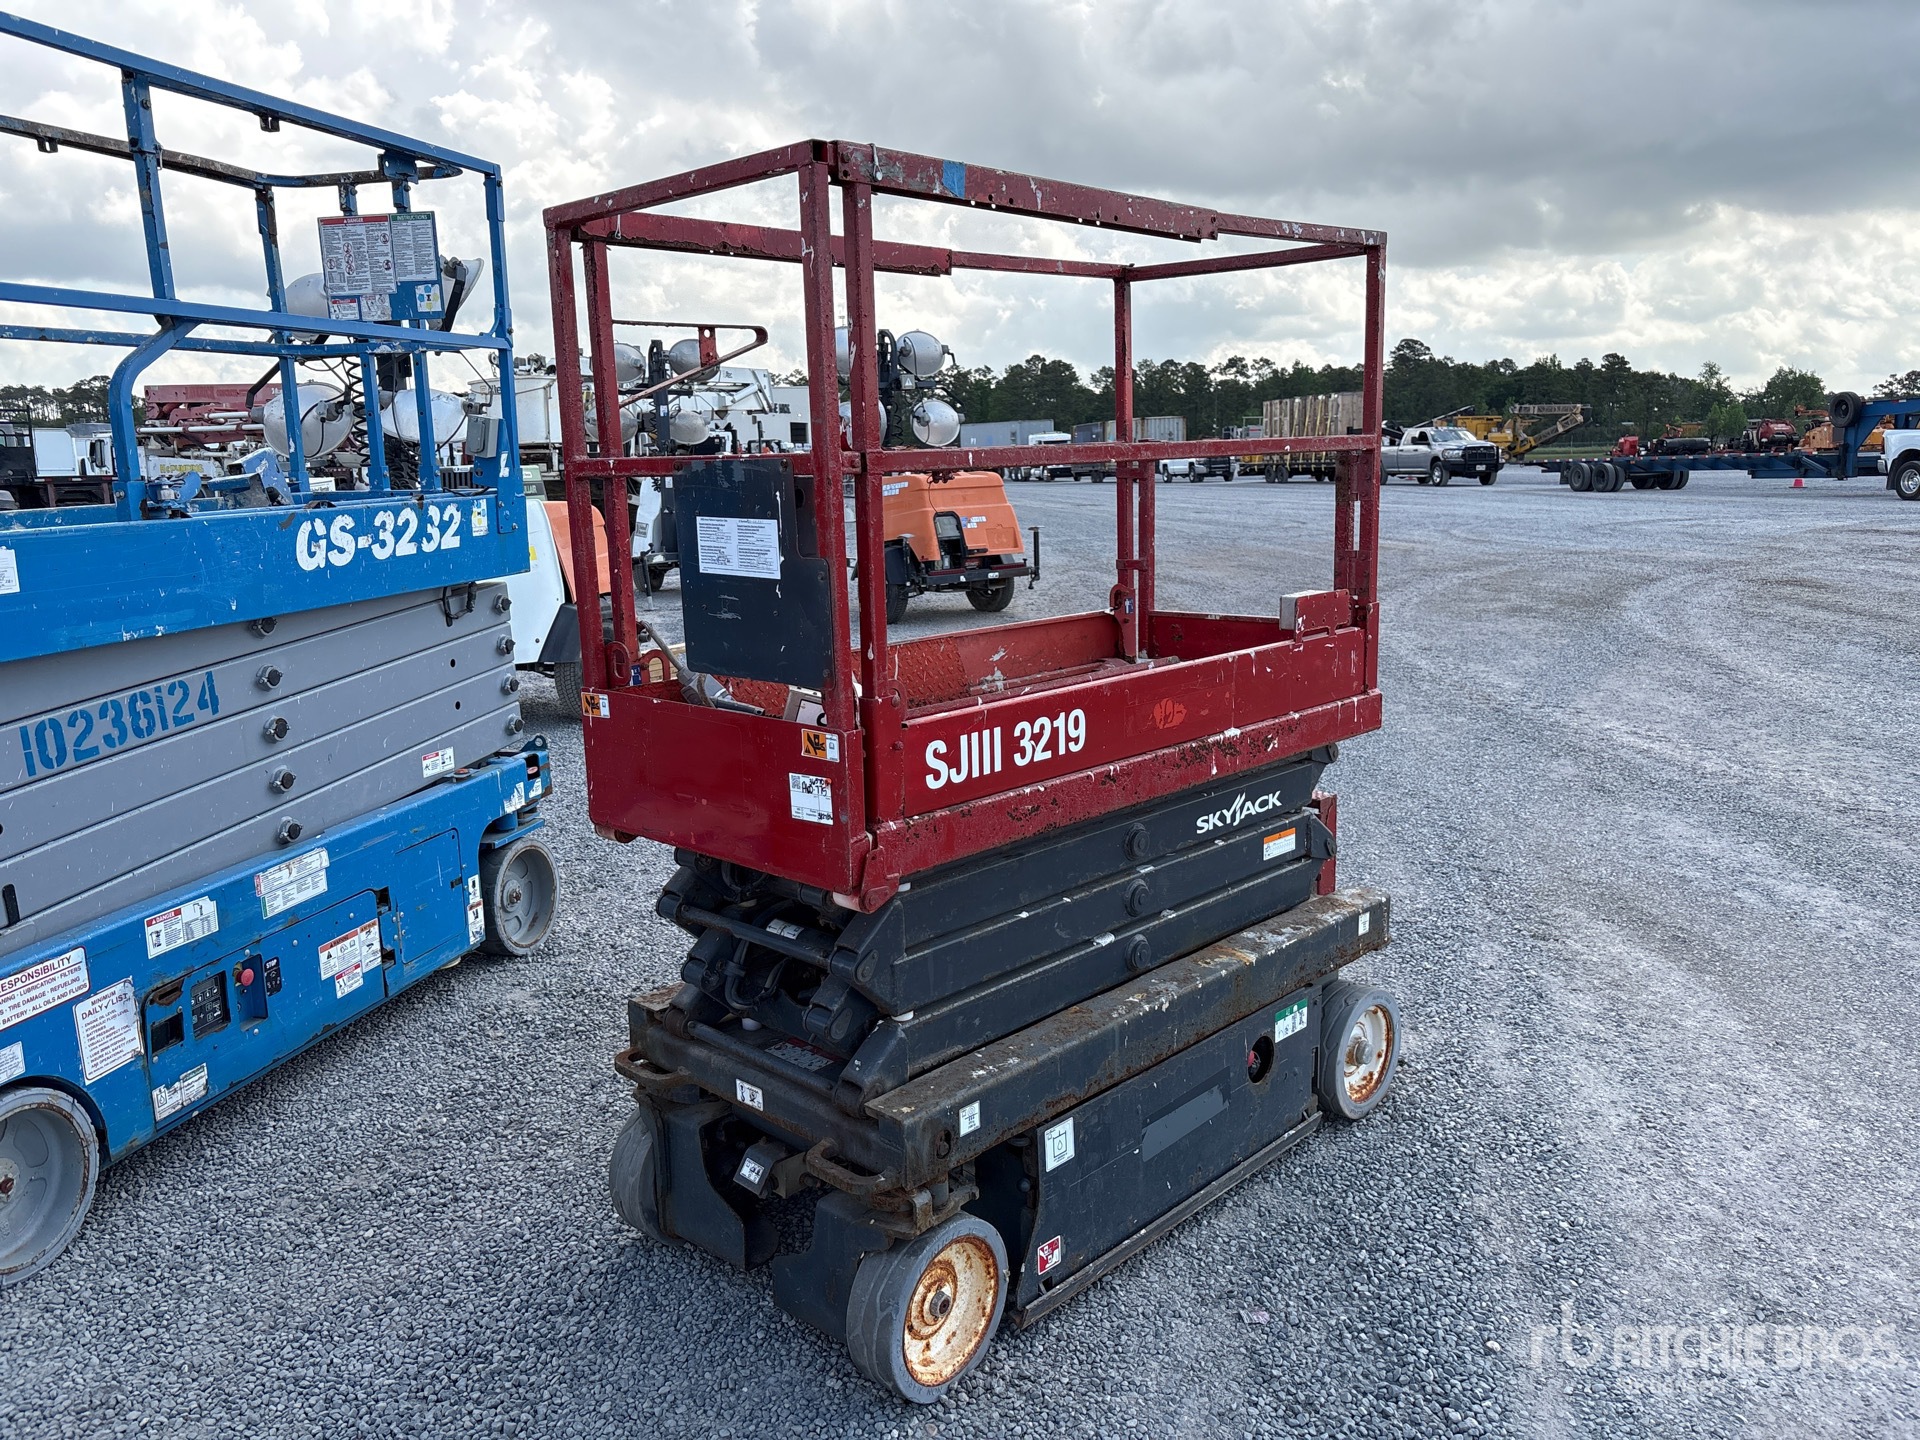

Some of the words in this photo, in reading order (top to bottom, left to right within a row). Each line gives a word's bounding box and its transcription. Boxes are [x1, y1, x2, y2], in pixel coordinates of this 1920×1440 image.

[296, 503, 461, 571] GS-3232
[19, 671, 219, 777] 10236124
[925, 727, 1002, 790] SJIII
[1013, 708, 1086, 767] 3219
[1196, 790, 1282, 834] SKYJACK
[19, 976, 56, 996] LUBRICATION
[59, 965, 81, 979] FILTERS
[266, 959, 277, 969] STOP
[2, 1008, 27, 1025] BATTERY
[31, 1002, 42, 1012] ALL
[43, 996, 55, 1006] OILS
[56, 990, 68, 1000] AND
[68, 982, 87, 995] FLUIDS
[8, 1001, 20, 1012] TIRE
[22, 990, 45, 1006] DAMAGE
[50, 975, 80, 993] REFUELING
[81, 1003, 104, 1020] DAILY
[111, 990, 128, 1005] LIST
[91, 989, 116, 1006] MINIMUM
